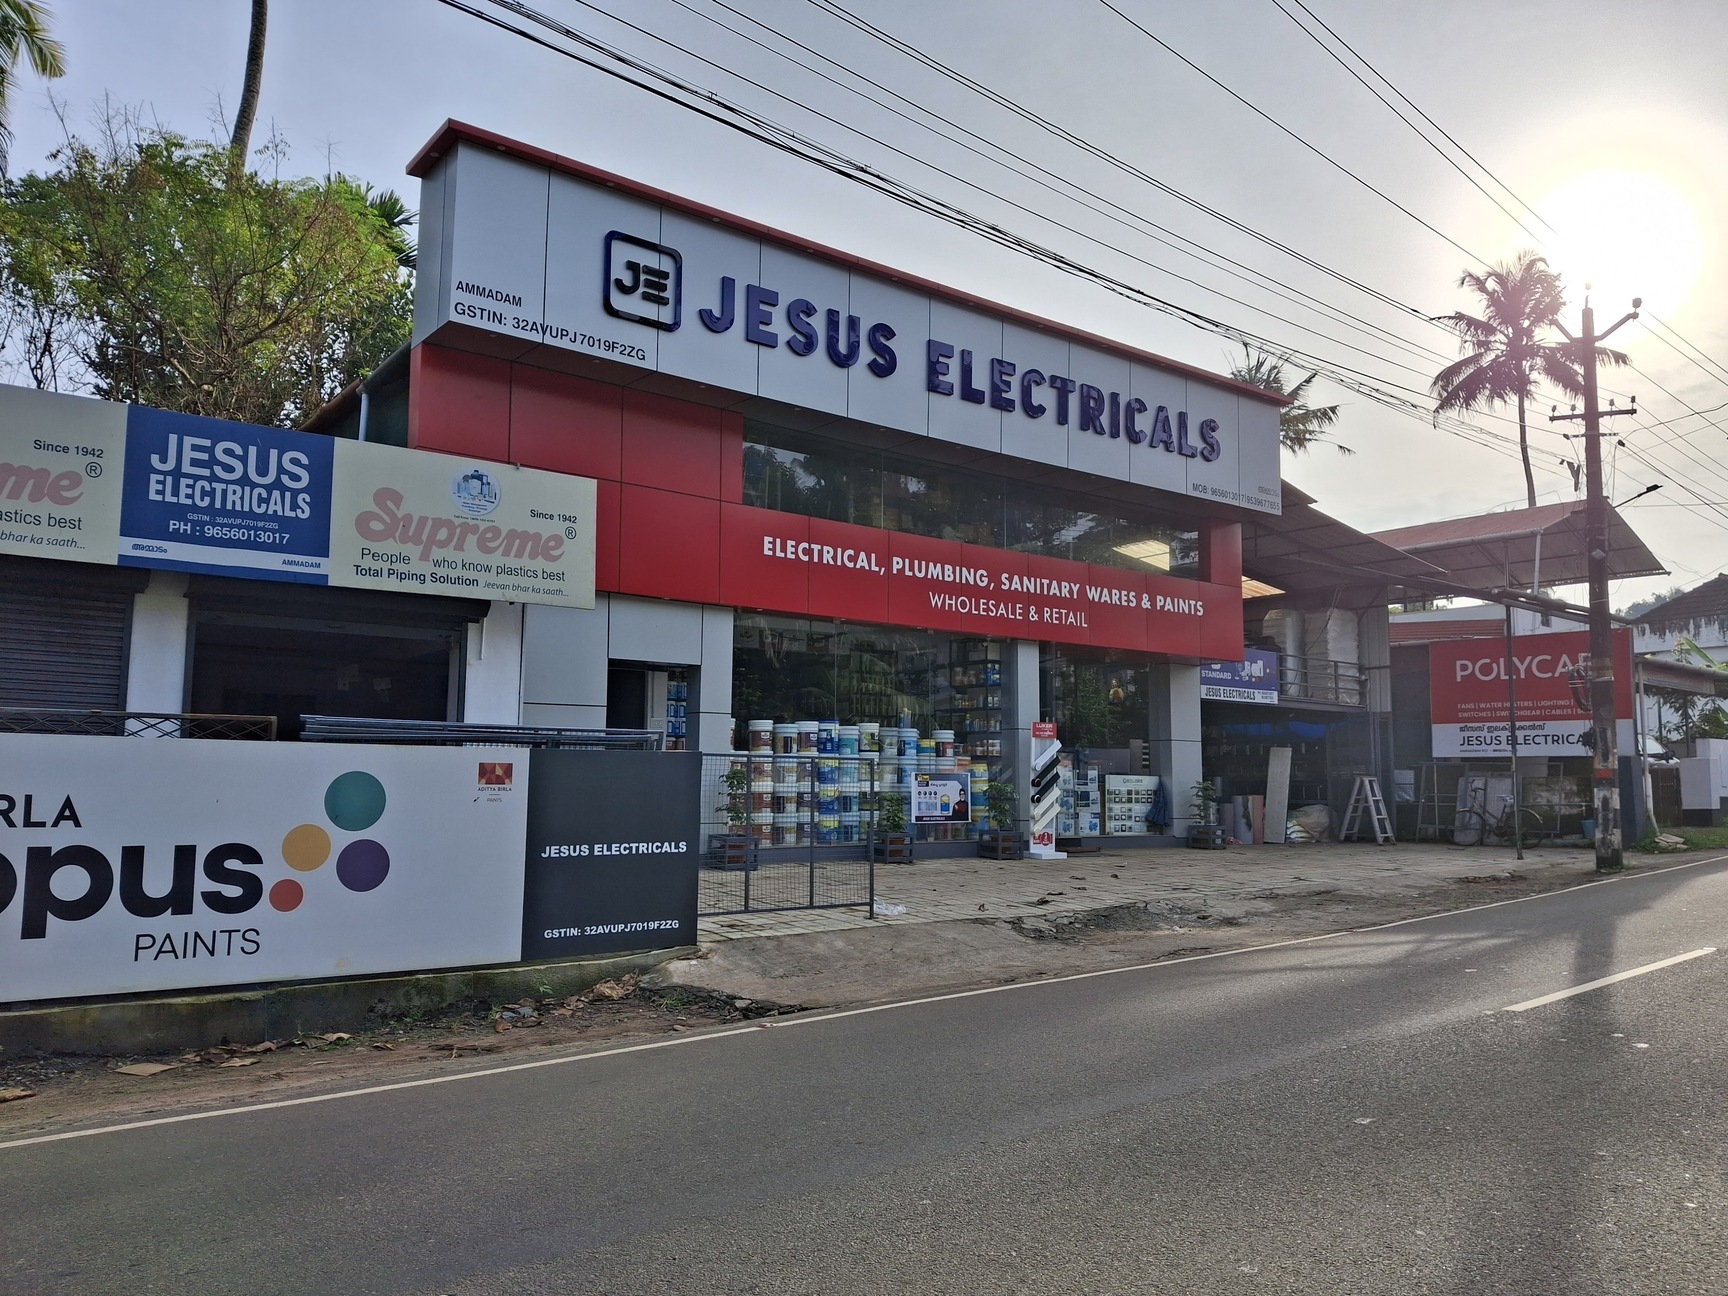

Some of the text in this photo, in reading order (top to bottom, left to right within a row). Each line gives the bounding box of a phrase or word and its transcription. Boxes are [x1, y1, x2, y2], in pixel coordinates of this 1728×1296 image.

[455, 280, 522, 308] AMMADAM
[454, 301, 646, 361] GSTIN: 32AVUPJ7019F2ZG
[698, 275, 1222, 463] JESUS ELECTRICALS
[33, 439, 104, 459] Since 1942
[151, 433, 310, 489] JESUS
[148, 473, 311, 520] ELECTRICALS
[1192, 482, 1210, 495] MOB:
[0, 509, 82, 530] stics best
[187, 512, 210, 522] GSTIN
[215, 516, 279, 529] 32AVUPJ7019F2ZG
[355, 487, 565, 562] Supreme
[530, 509, 577, 524] Since 1942
[0, 530, 28, 543] bhar
[30, 534, 43, 545] ka
[169, 520, 191, 535] PH
[204, 525, 290, 545] 9656013017
[282, 559, 321, 569] AMMADAM
[361, 547, 566, 582] People who know plastics best
[763, 535, 1204, 616] ELECTRICAL, PLUMBING, SANITARY WARES & PAINTS
[353, 564, 383, 578] Total
[387, 568, 426, 585] Piping
[430, 573, 479, 587] Solution
[482, 580, 511, 591] Jeevan
[511, 582, 531, 593] bhar
[532, 584, 541, 594] ka
[929, 591, 1088, 628] WHOLESALE & RETAIL
[1201, 670, 1232, 680] STANDARD
[1205, 687, 1221, 698] JESUS
[1222, 688, 1256, 701] ELECTRICALS
[1458, 710, 1491, 718] SWITCHES
[1545, 708, 1572, 716] CABLES
[1459, 733, 1585, 747] JESUS ELECTRICA
[541, 841, 687, 858] JESUS ELECTRICALS
[0, 842, 264, 940] pus
[544, 919, 680, 939] GSTIN: 32AVUPJ7019F2ZG
[133, 928, 261, 962] PAINTS
